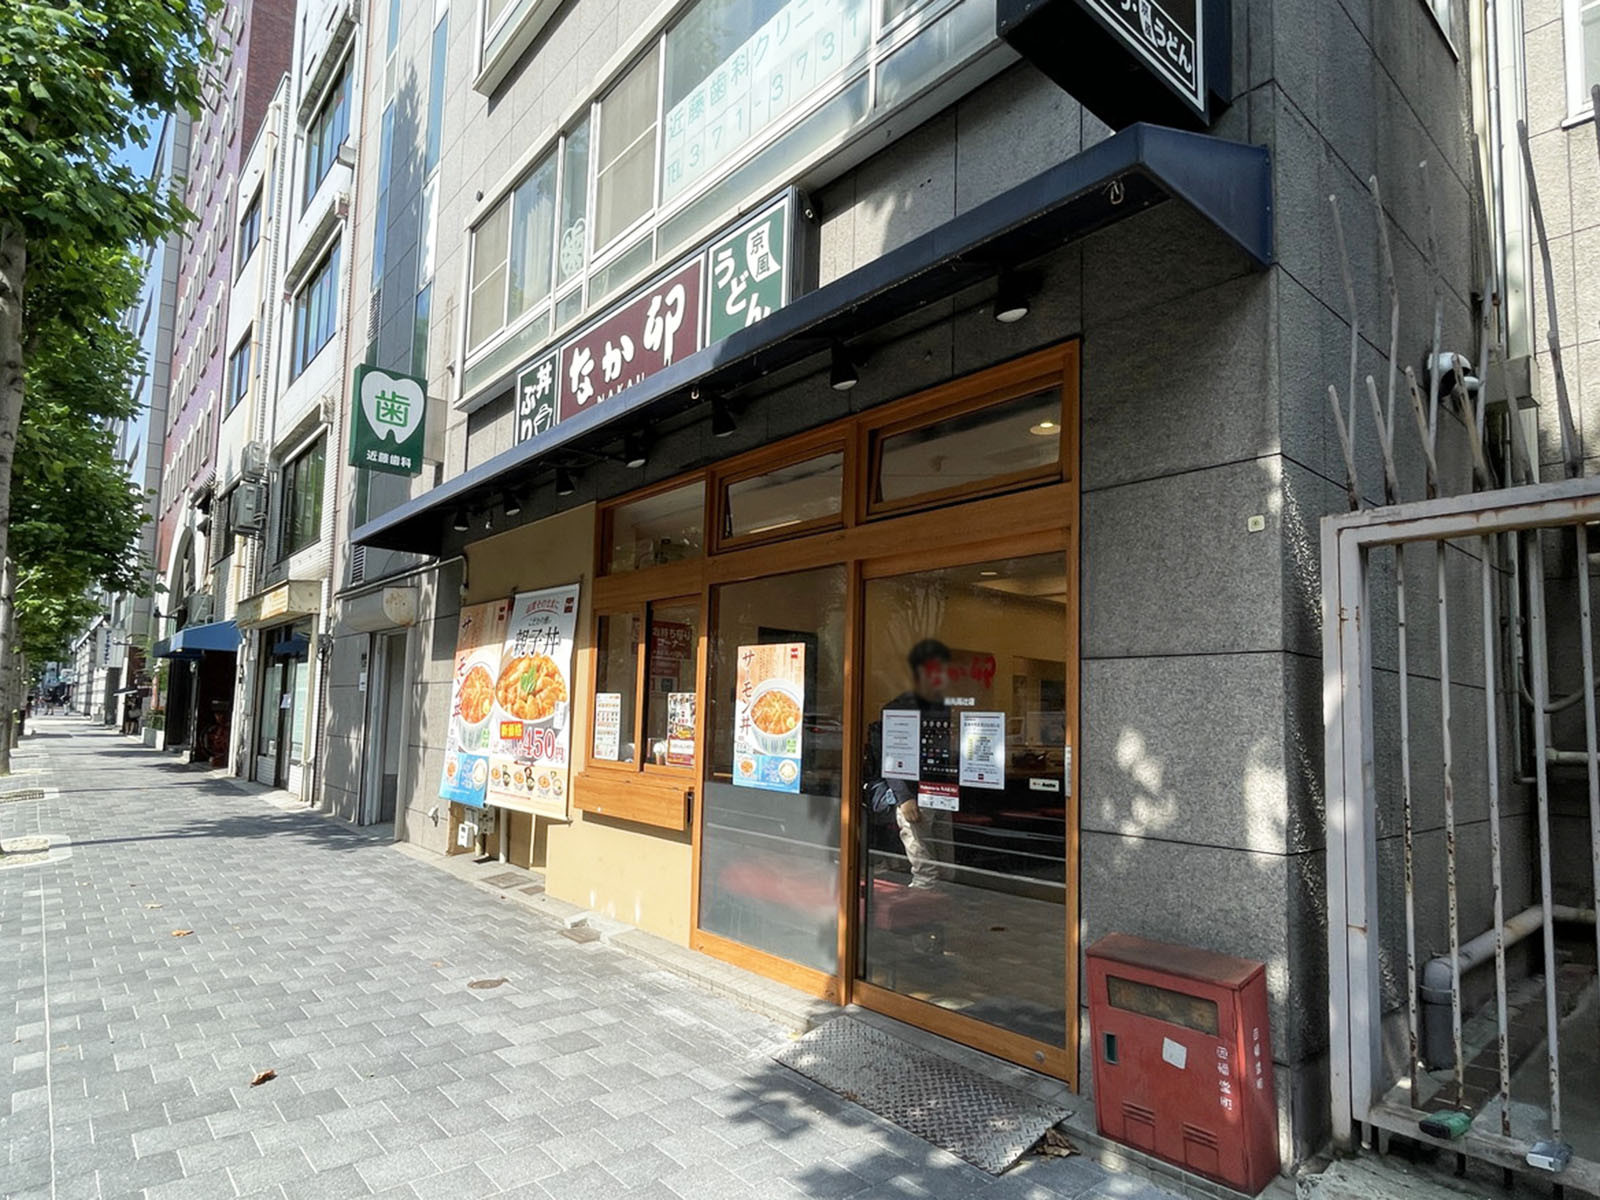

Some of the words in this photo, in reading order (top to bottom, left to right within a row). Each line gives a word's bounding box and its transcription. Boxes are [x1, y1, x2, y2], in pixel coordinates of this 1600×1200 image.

[1154, 17, 1192, 74] うどん
[750, 230, 770, 278] 京風
[569, 283, 685, 405] なか卯
[374, 390, 411, 428] 歯
[513, 625, 561, 657] 親子丼
[740, 649, 755, 736] サーモン丼
